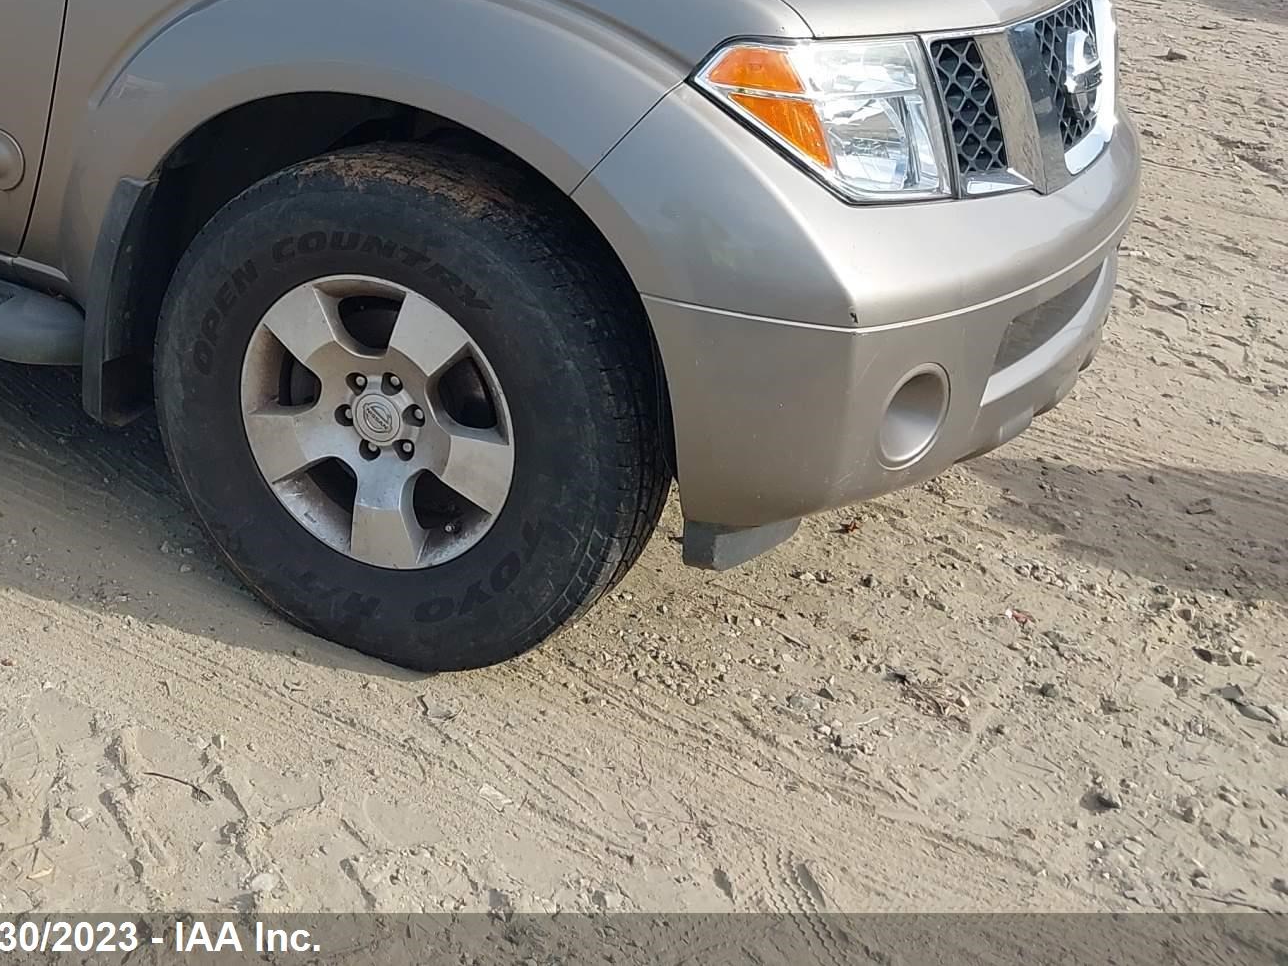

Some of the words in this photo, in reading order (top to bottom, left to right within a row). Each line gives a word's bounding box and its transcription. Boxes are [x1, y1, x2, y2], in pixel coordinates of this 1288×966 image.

[193, 258, 259, 377] OPEN
[271, 230, 494, 311] COUNTRY
[414, 518, 546, 622] TOYO
